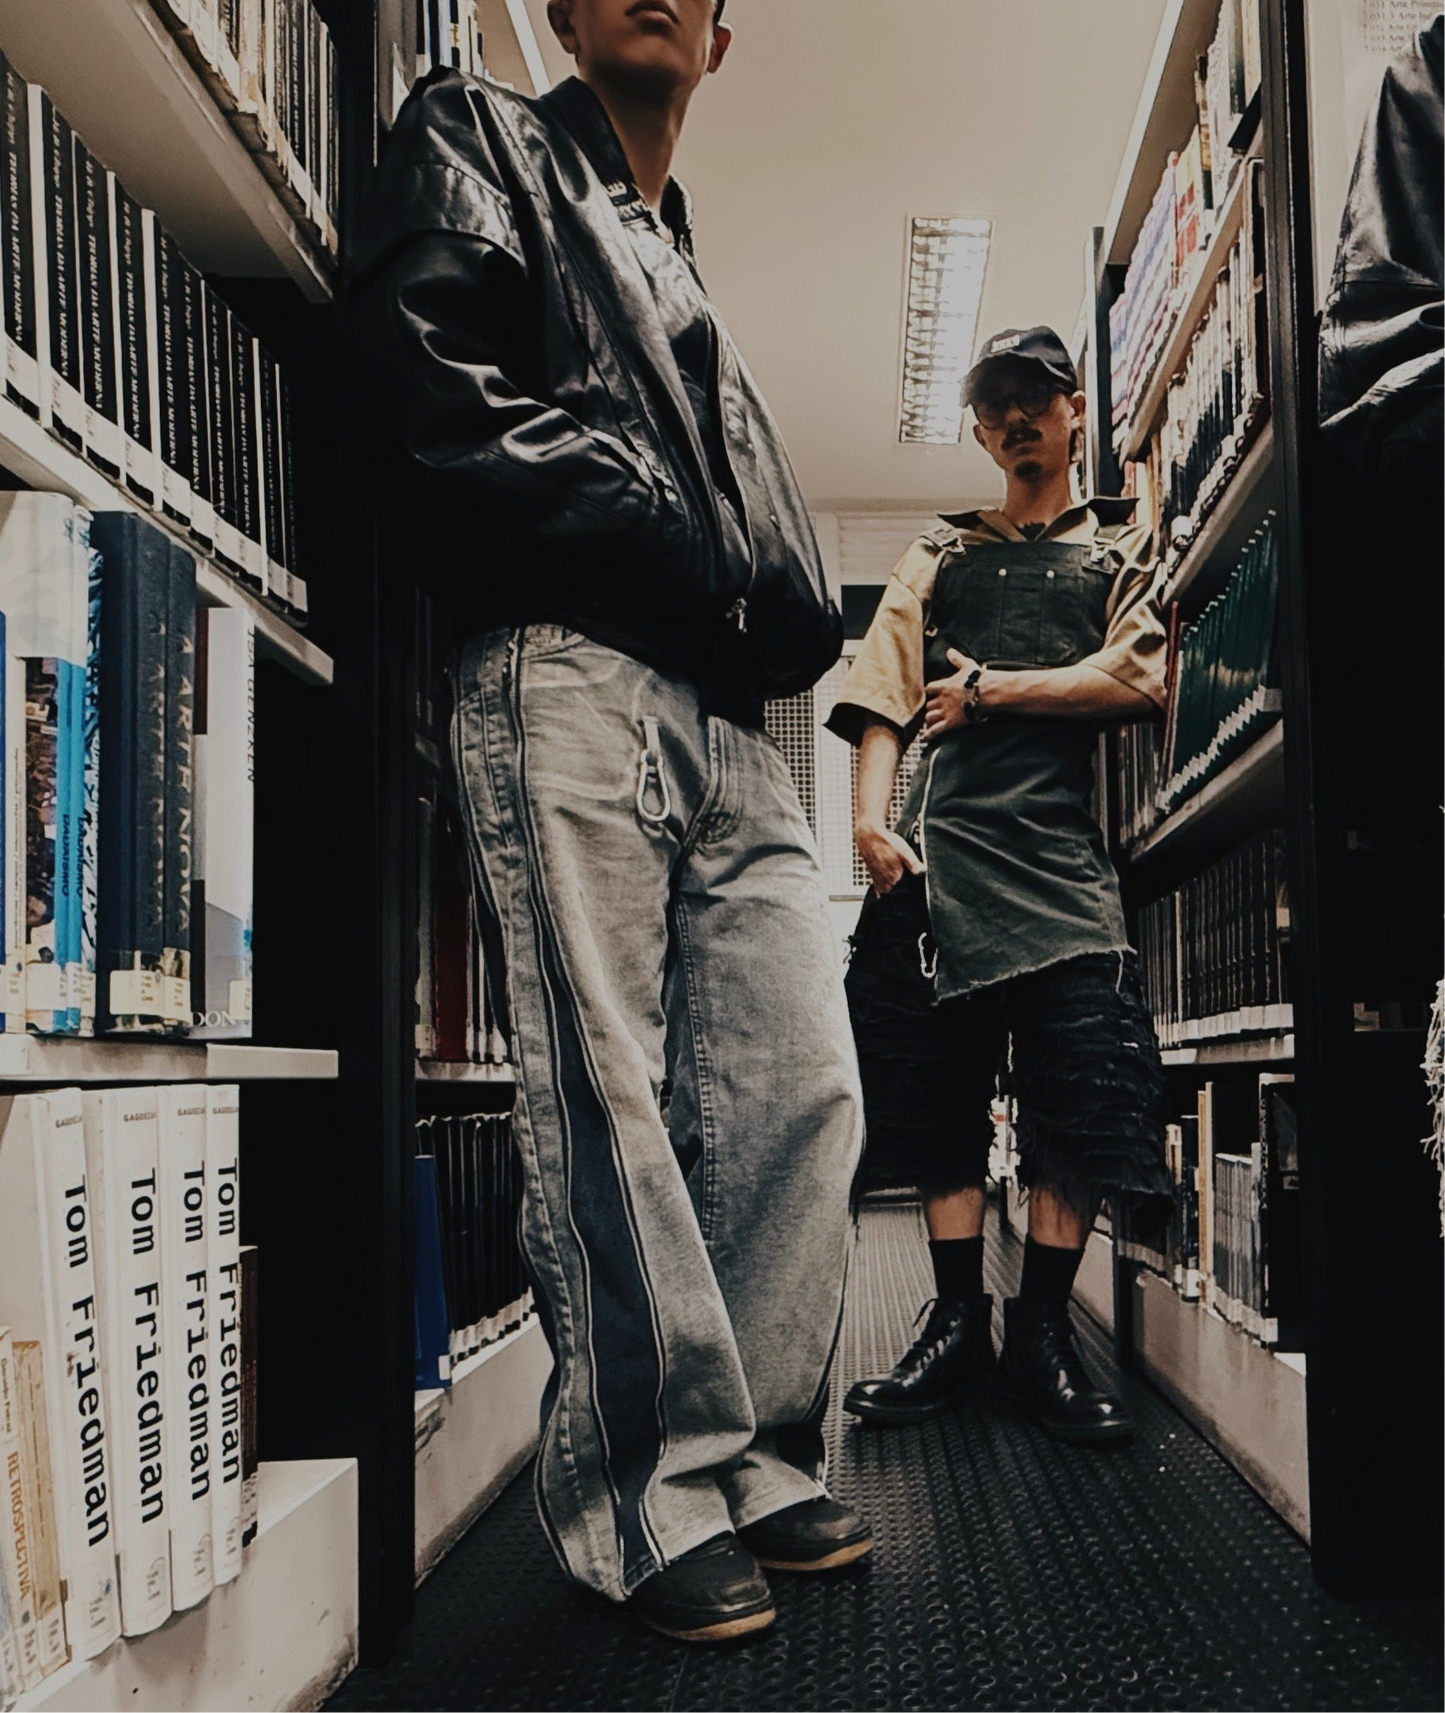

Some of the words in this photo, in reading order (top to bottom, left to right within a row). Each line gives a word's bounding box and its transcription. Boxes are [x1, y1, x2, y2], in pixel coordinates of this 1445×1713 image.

[181, 634, 194, 654] A
[177, 675, 193, 794] ARTE
[61, 813, 70, 898] DADAISMO
[76, 816, 85, 898] DADAISMO
[177, 807, 192, 932] NOVA
[192, 1010, 235, 1028] DON
[65, 1173, 90, 1268] Tom
[131, 1167, 156, 1255] Tom
[183, 1160, 205, 1243] Tom
[218, 1157, 238, 1236] Tom
[72, 1294, 110, 1547] Friedman
[133, 1281, 164, 1524] Friedman
[185, 1269, 210, 1501] Friedman
[219, 1262, 242, 1484] Friedman
[7, 1450, 32, 1600] RETROSPECTIVA
